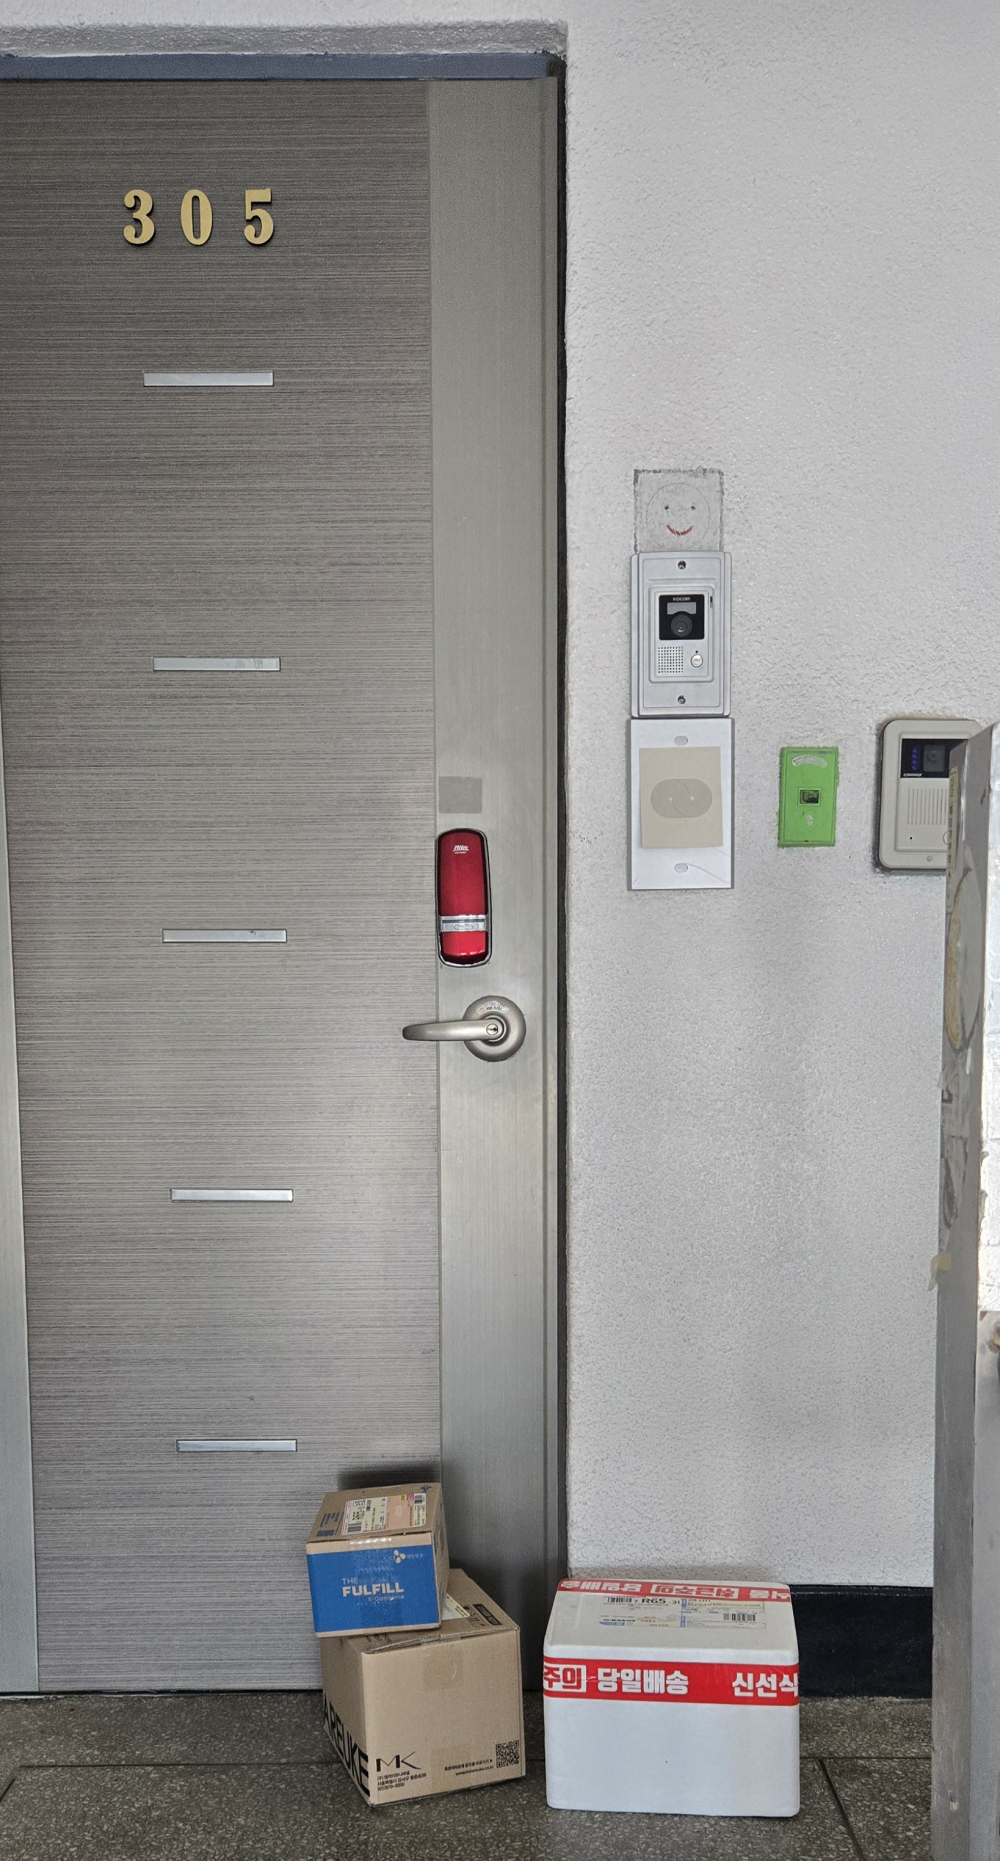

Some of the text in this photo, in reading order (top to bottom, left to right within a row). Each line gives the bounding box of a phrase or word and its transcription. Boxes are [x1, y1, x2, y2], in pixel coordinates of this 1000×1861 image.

[123, 187, 275, 247] 305
[342, 1577, 359, 1585] THE
[560, 1581, 642, 1593] 당일배송
[342, 1582, 405, 1597] FULFILL
[654, 1585, 735, 1599] 취급주의
[597, 1667, 689, 1695] 당일배송
[376, 1751, 422, 1772] MK
